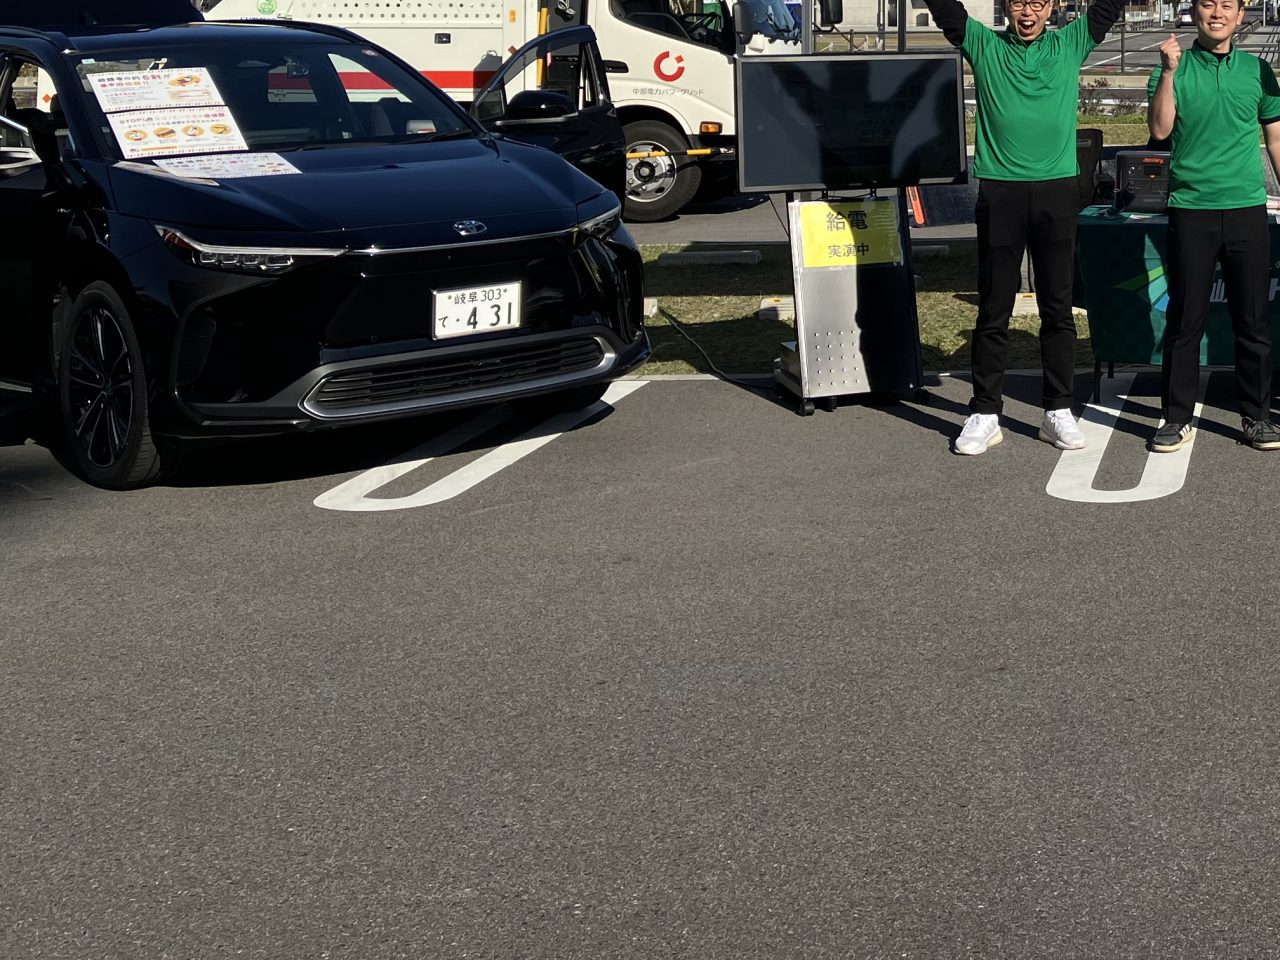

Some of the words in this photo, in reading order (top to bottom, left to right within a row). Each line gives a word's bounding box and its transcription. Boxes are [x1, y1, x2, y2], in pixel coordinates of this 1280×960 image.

[632, 87, 705, 96] 中部電力パワーグリッド
[826, 210, 868, 231] 給電
[828, 242, 869, 257] 実演中
[454, 292, 478, 305] 岐阜
[480, 288, 501, 302] 303
[438, 315, 449, 328] て
